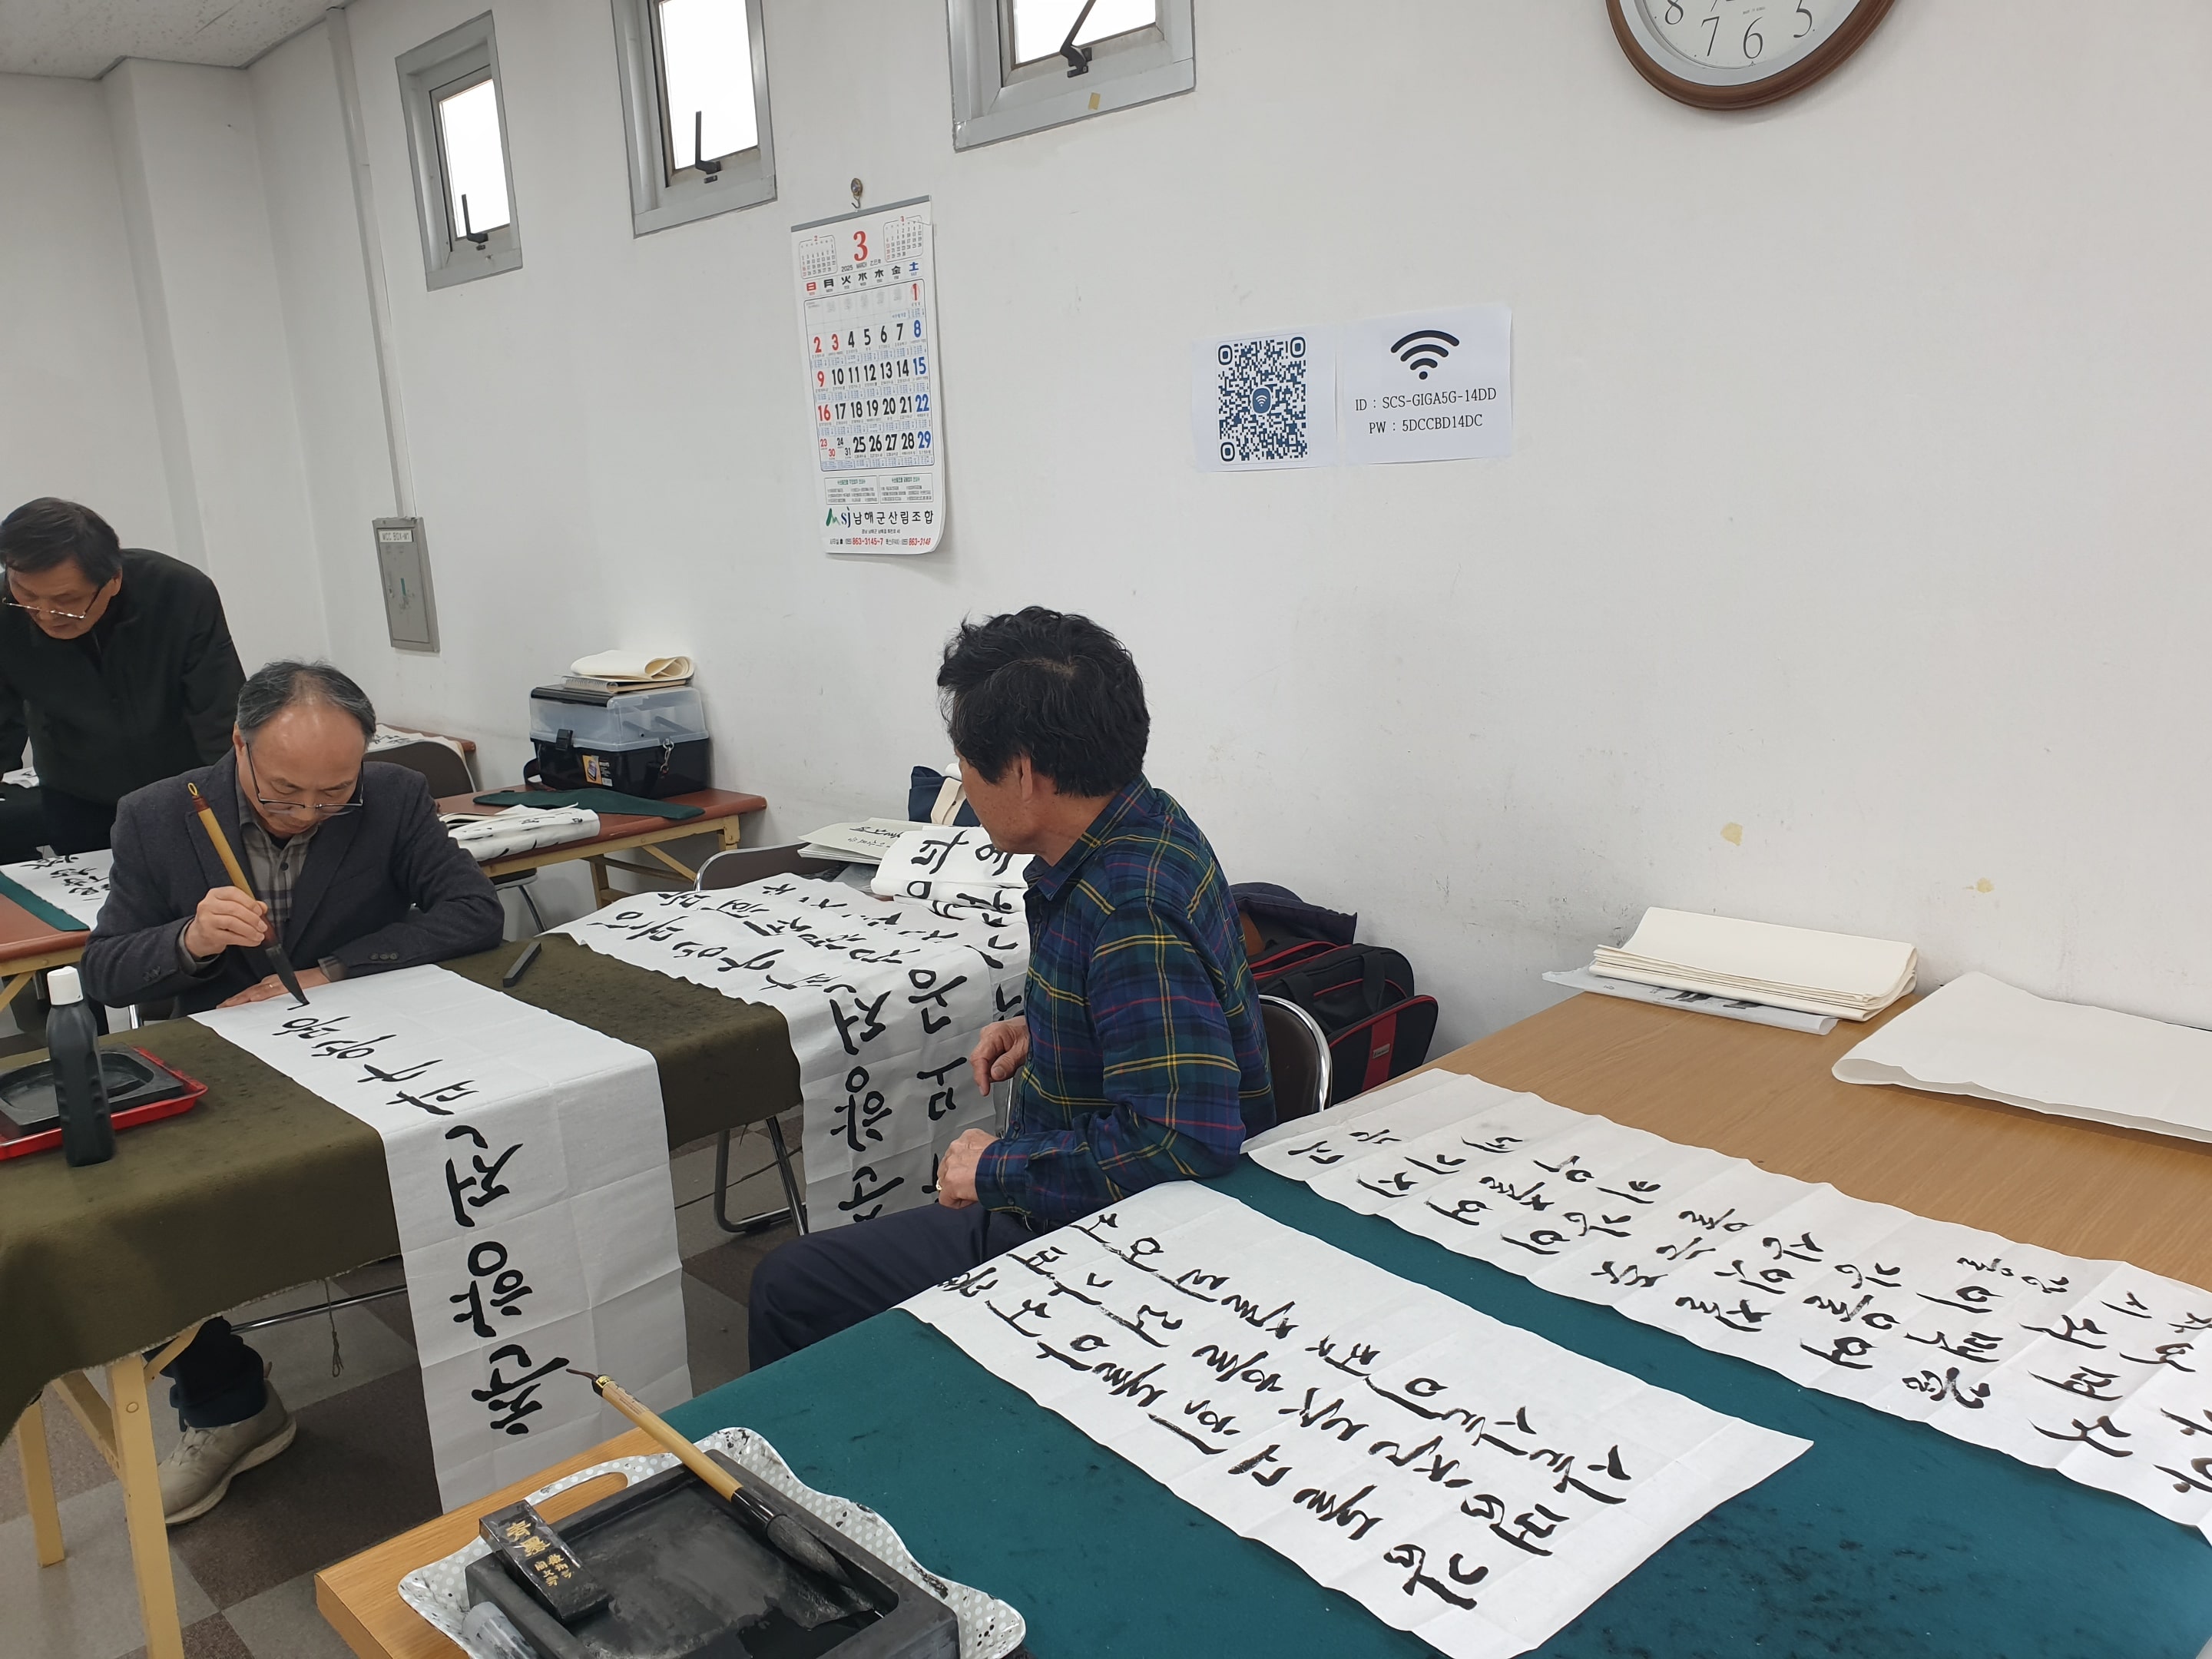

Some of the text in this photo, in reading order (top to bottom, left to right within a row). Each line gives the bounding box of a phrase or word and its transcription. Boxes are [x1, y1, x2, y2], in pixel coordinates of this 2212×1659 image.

[1700, 16, 1720, 57] 7
[1743, 17, 1763, 59] 6
[853, 230, 869, 262] 3
[841, 264, 853, 273] 2025
[875, 269, 884, 278] 木
[891, 265, 902, 276] 金
[909, 261, 919, 272] 土
[841, 275, 851, 286] 火
[858, 272, 868, 282] 水
[912, 283, 919, 302] 1
[813, 320, 922, 353] 2 3 4 5 6 7 8
[817, 356, 926, 387] 9 10 11 12 13 14 15
[818, 393, 929, 422] 16 17 18 19 20 21 22
[1355, 387, 1497, 411] ID SCS-GIGA5G-14DD
[1369, 414, 1483, 434] PW 5DCCBD14DC
[820, 430, 932, 455] 23 24 25 26 27 28 29
[829, 448, 852, 457] 30 31
[853, 510, 934, 525] 남해군산림조합
